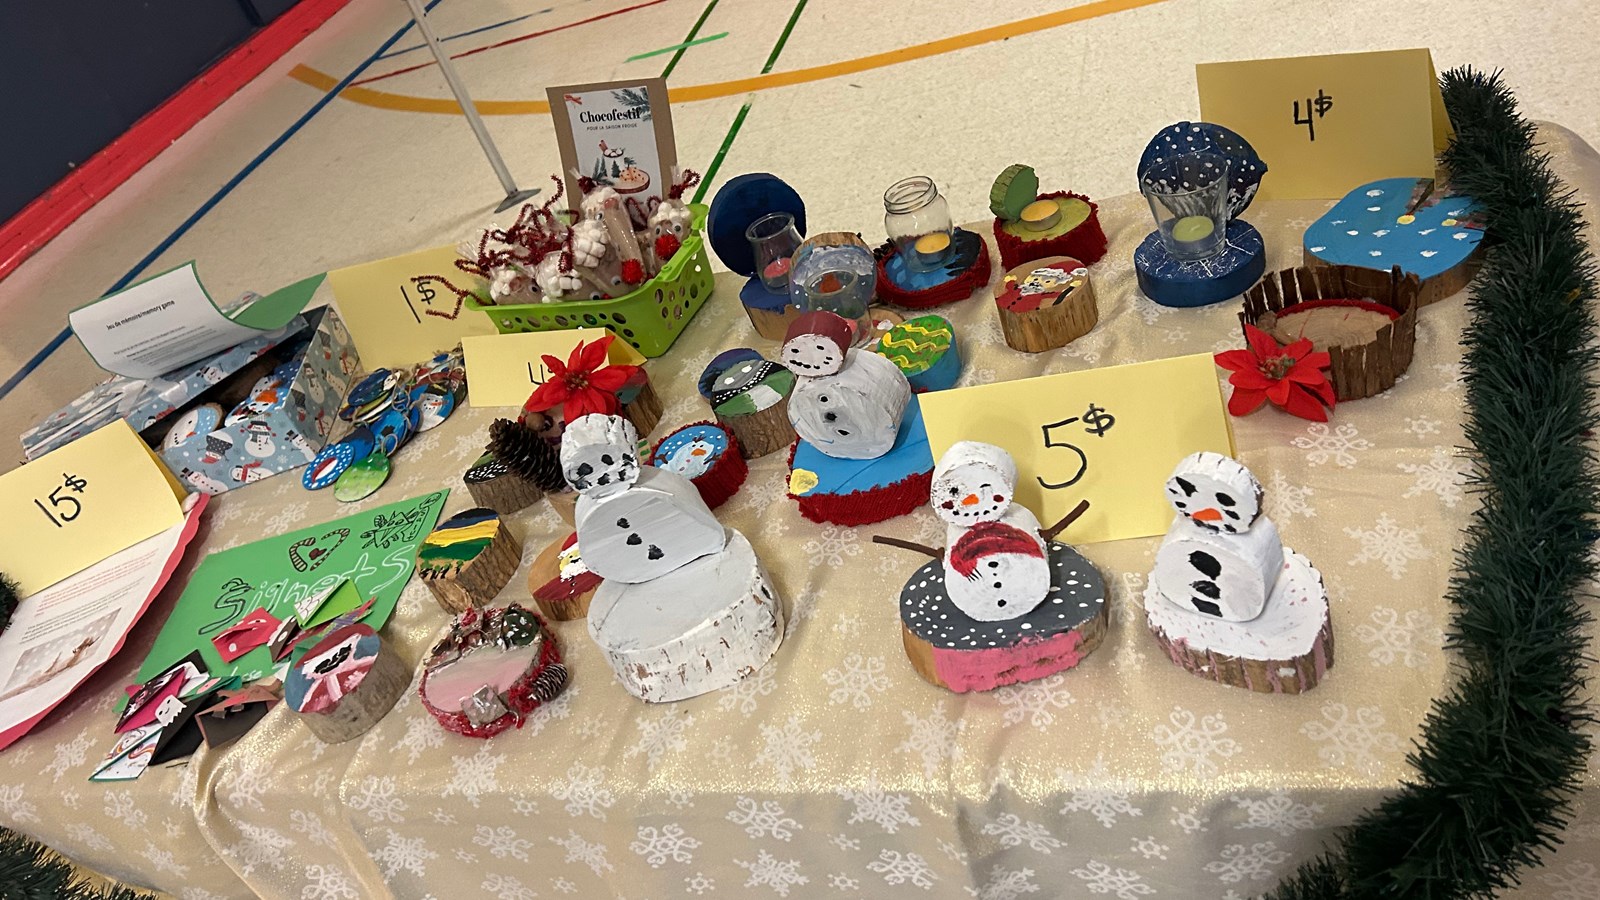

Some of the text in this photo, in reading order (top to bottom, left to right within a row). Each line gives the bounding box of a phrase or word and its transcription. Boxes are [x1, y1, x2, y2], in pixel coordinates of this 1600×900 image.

[579, 107, 641, 124] Chocofestif
[1293, 88, 1333, 142] 4$
[400, 280, 436, 324] 1$
[1036, 402, 1116, 490] 5$
[34, 472, 87, 528] 15$
